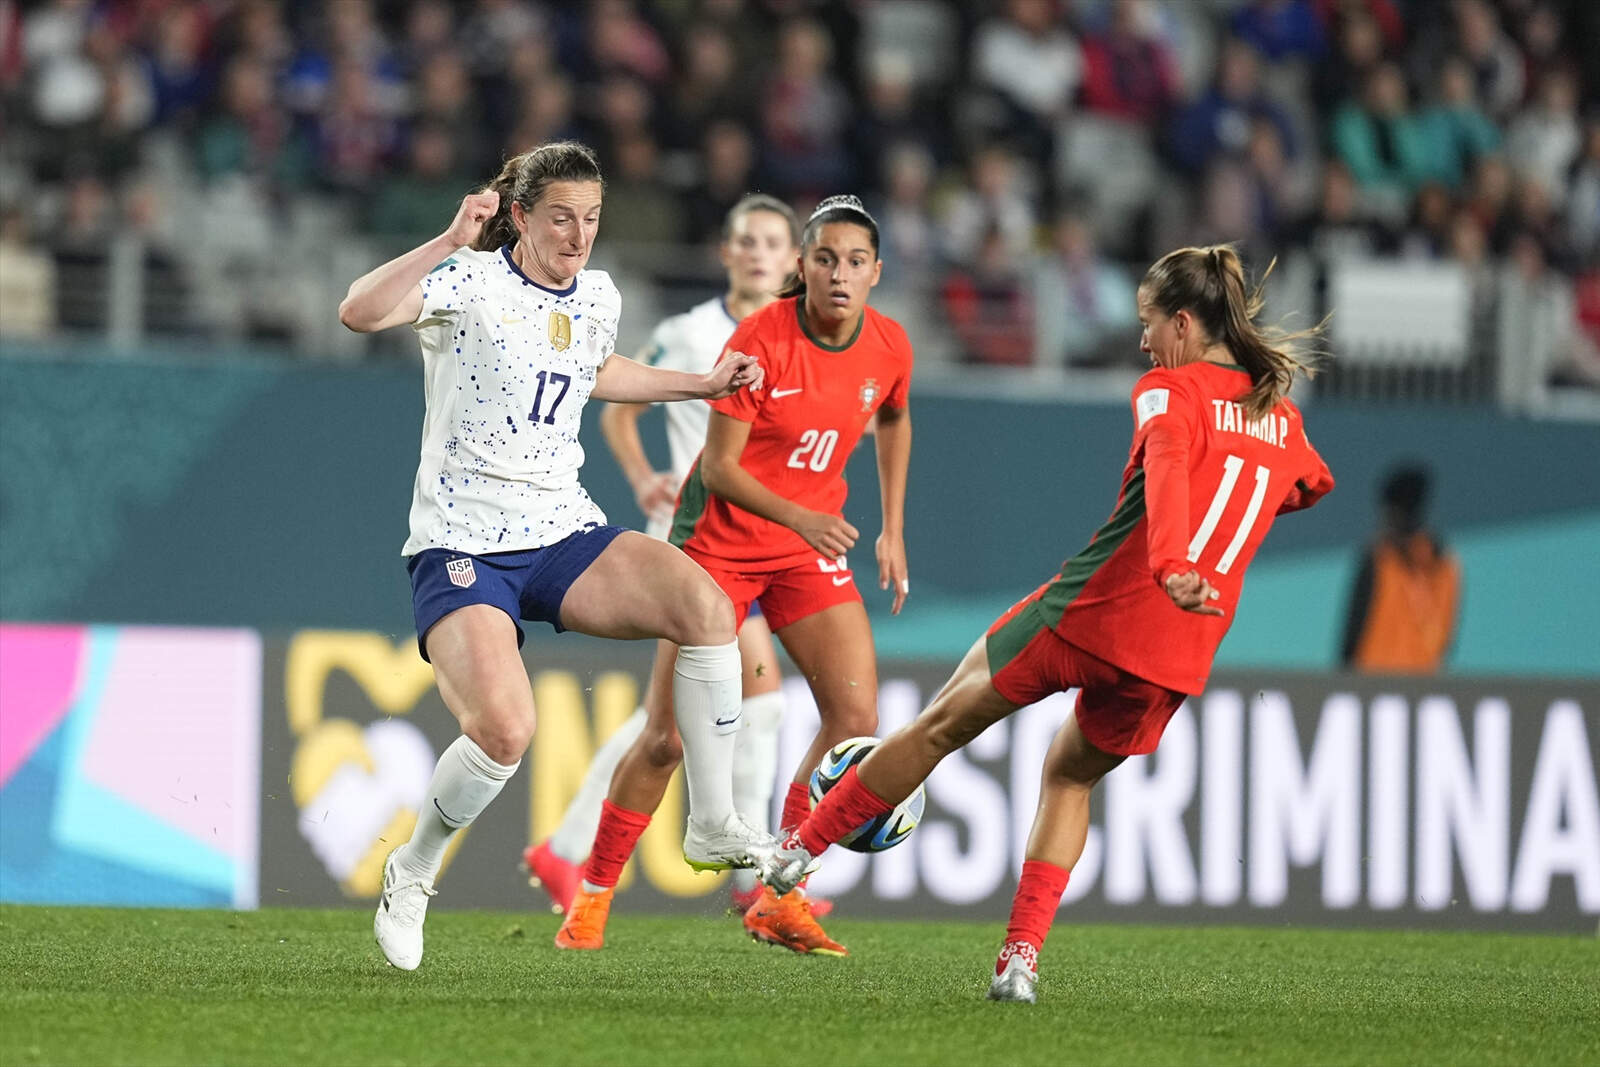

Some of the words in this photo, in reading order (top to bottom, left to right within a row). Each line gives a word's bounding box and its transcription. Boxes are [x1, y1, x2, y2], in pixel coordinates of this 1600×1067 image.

[528, 370, 571, 425] 17
[787, 429, 839, 472] 20
[1279, 416, 1288, 449] P.
[1186, 454, 1271, 575] 11
[448, 560, 471, 572] USA
